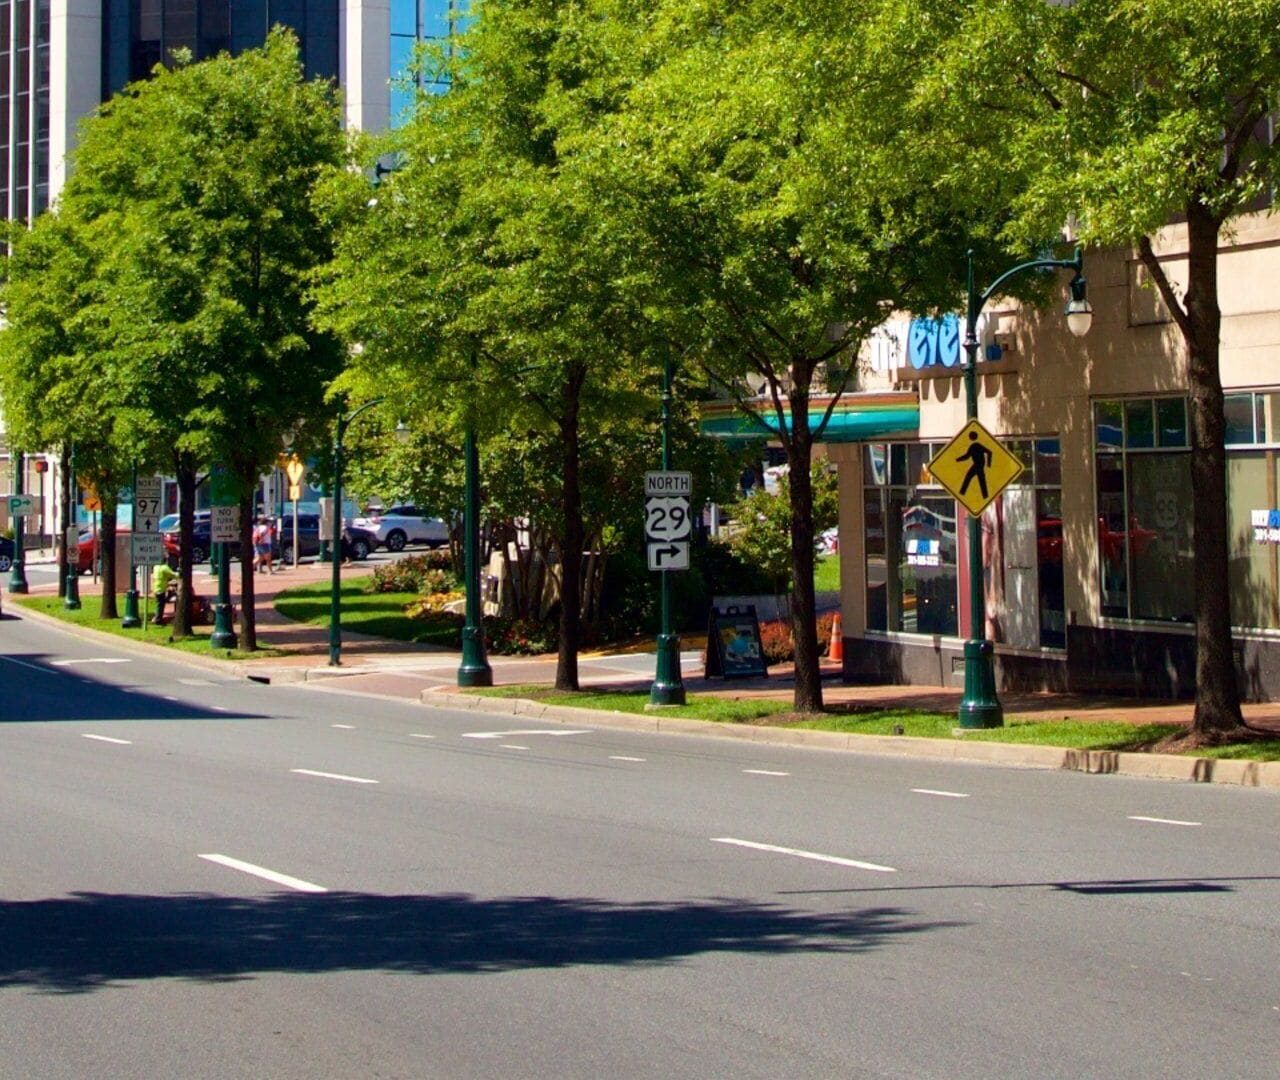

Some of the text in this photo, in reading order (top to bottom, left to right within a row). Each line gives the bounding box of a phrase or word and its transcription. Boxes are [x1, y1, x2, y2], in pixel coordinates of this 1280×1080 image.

[648, 476, 689, 491] NORTH
[138, 499, 160, 514] 97
[650, 507, 686, 532] 29
